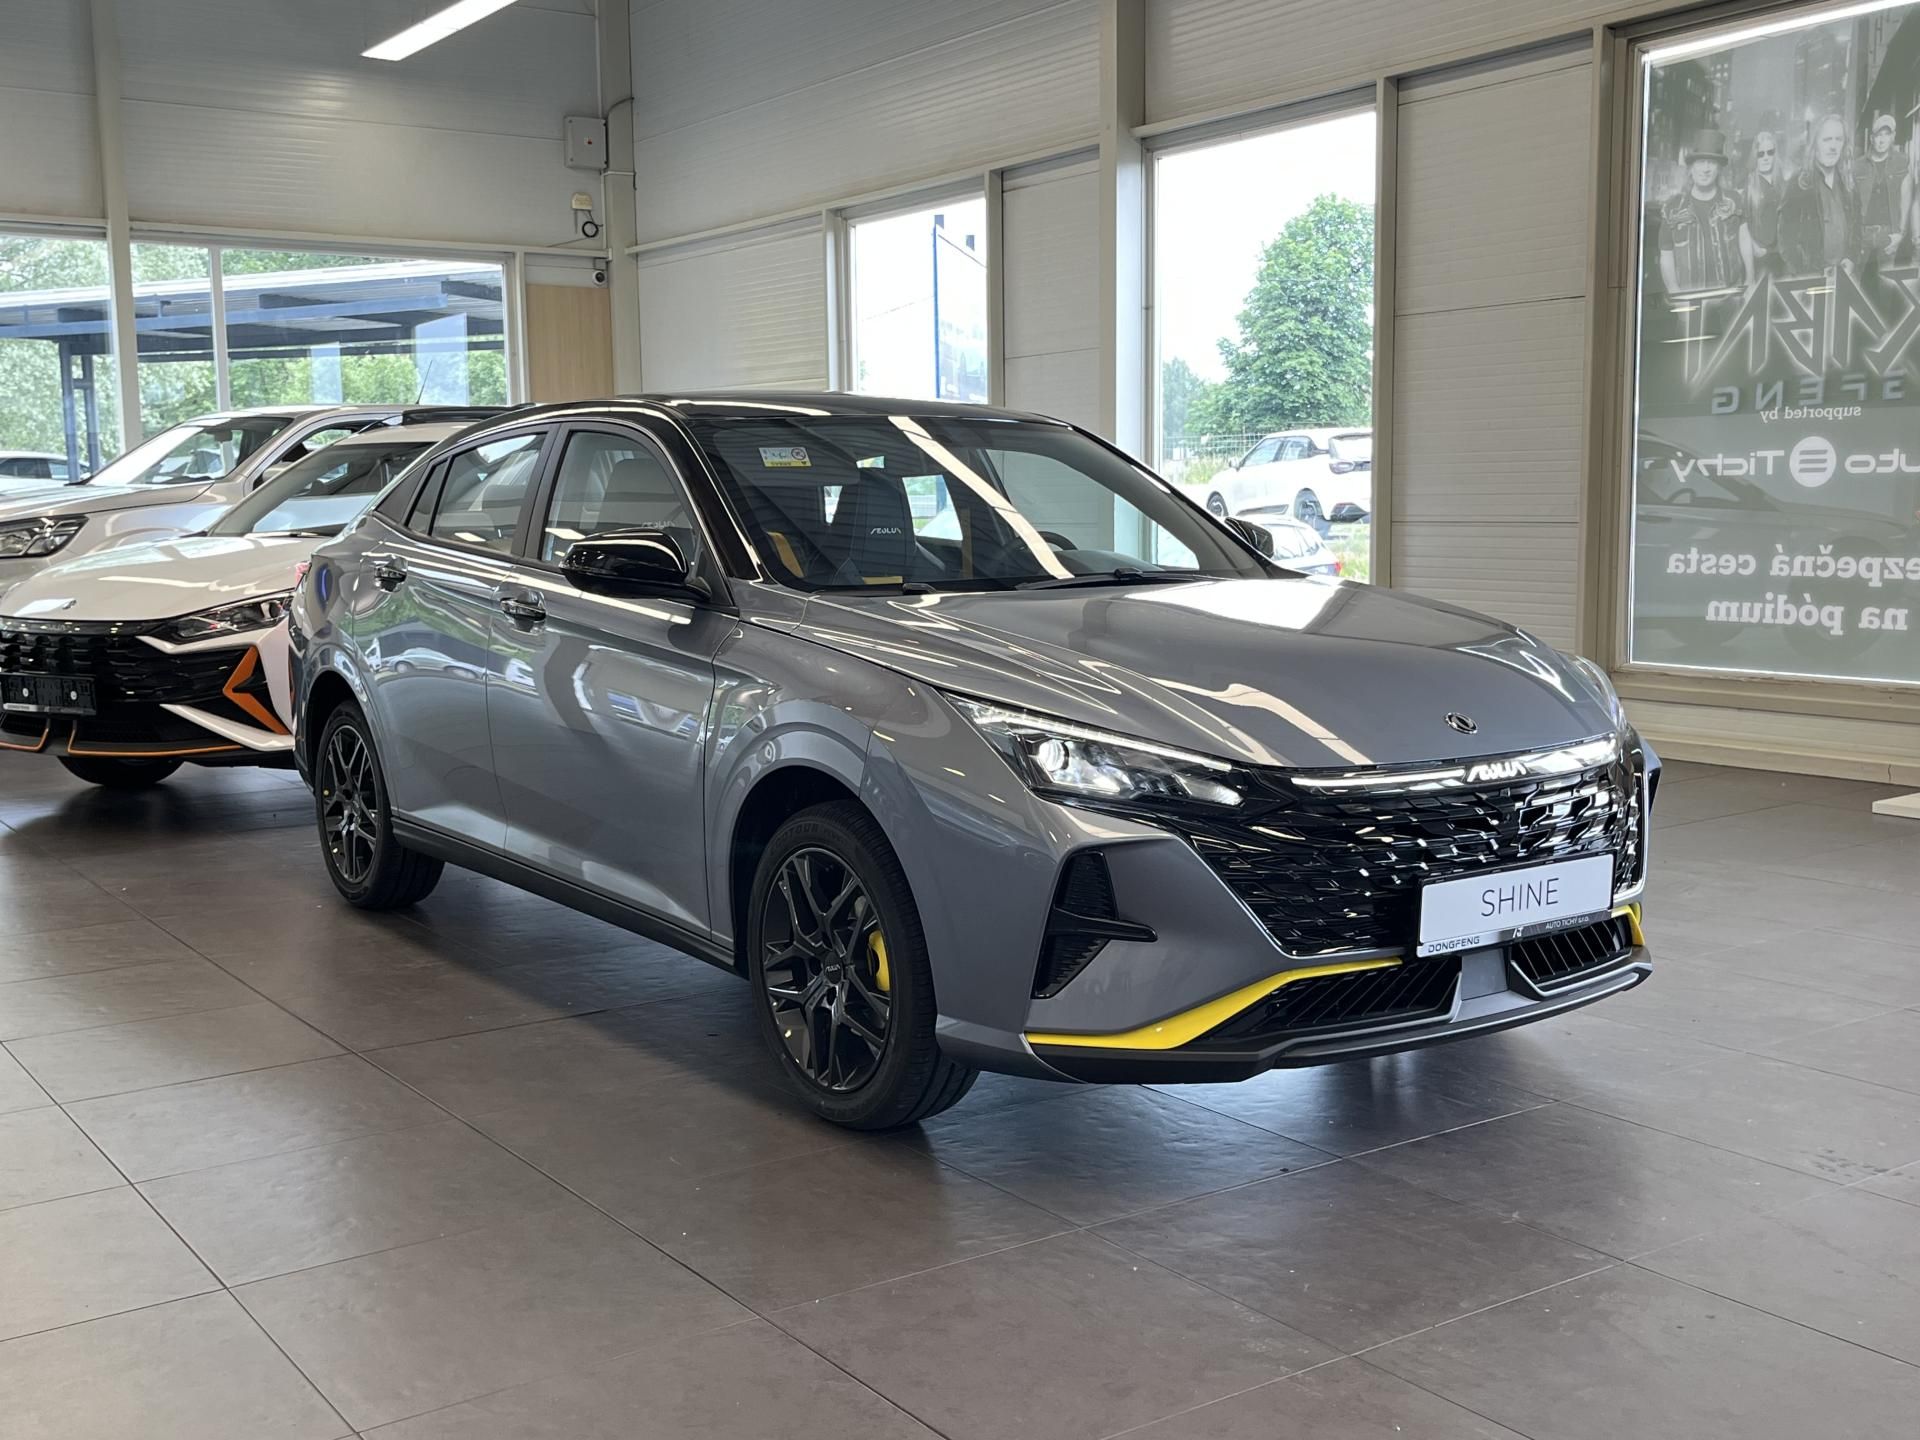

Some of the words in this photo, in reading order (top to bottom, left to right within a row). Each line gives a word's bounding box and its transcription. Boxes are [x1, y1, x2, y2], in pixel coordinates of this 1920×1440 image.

[1481, 877, 1560, 918] SHINE
[1545, 920, 1561, 930] AUTO
[1428, 936, 1480, 954] DONGFENG
